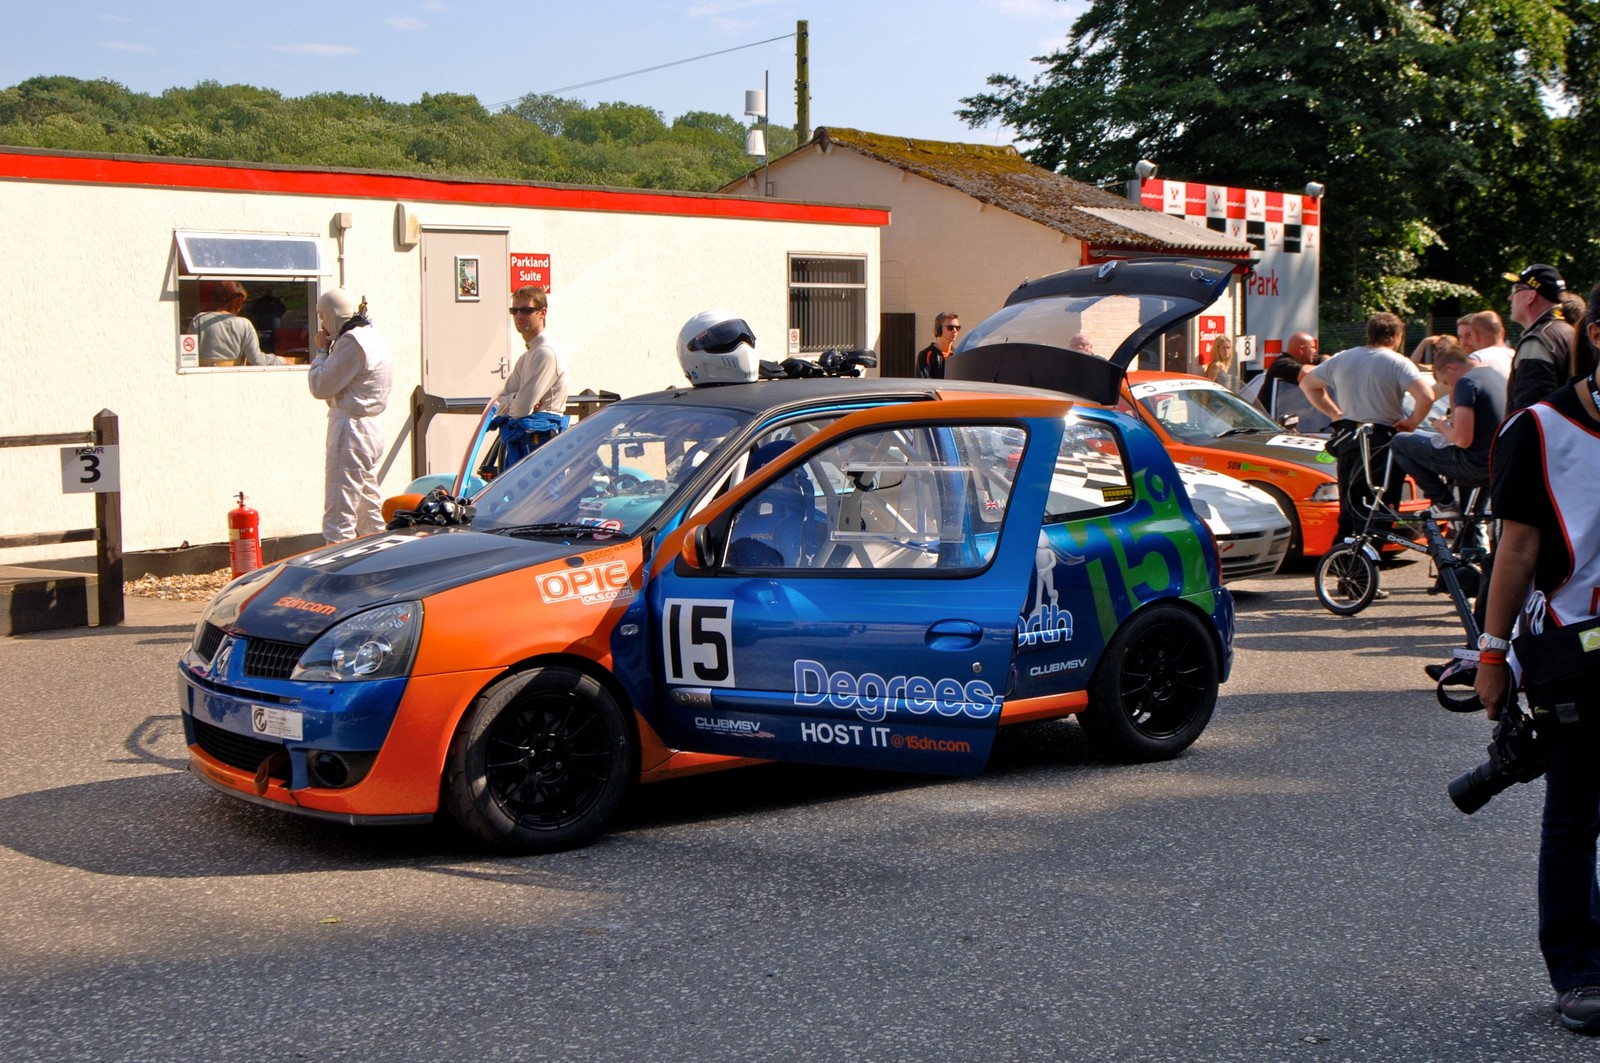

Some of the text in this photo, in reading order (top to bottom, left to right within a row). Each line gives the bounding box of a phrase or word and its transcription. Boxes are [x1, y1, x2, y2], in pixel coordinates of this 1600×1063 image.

[511, 256, 549, 268] Parkland
[519, 270, 542, 281] Suite
[1248, 269, 1280, 297] Park
[1207, 318, 1217, 329] No
[1244, 340, 1251, 356] 8
[75, 446, 105, 456] MSVR
[80, 455, 101, 484] 3
[1387, 534, 1428, 553] CHOPPER
[541, 562, 627, 599] OPIE
[274, 595, 337, 616] 15dn.com
[669, 604, 729, 681] 15
[1030, 658, 1088, 677] CLUBMSV
[794, 659, 995, 723] Degrees
[694, 716, 761, 732] CLUBMSV
[801, 722, 971, 753] HOST IT @15dn.com
